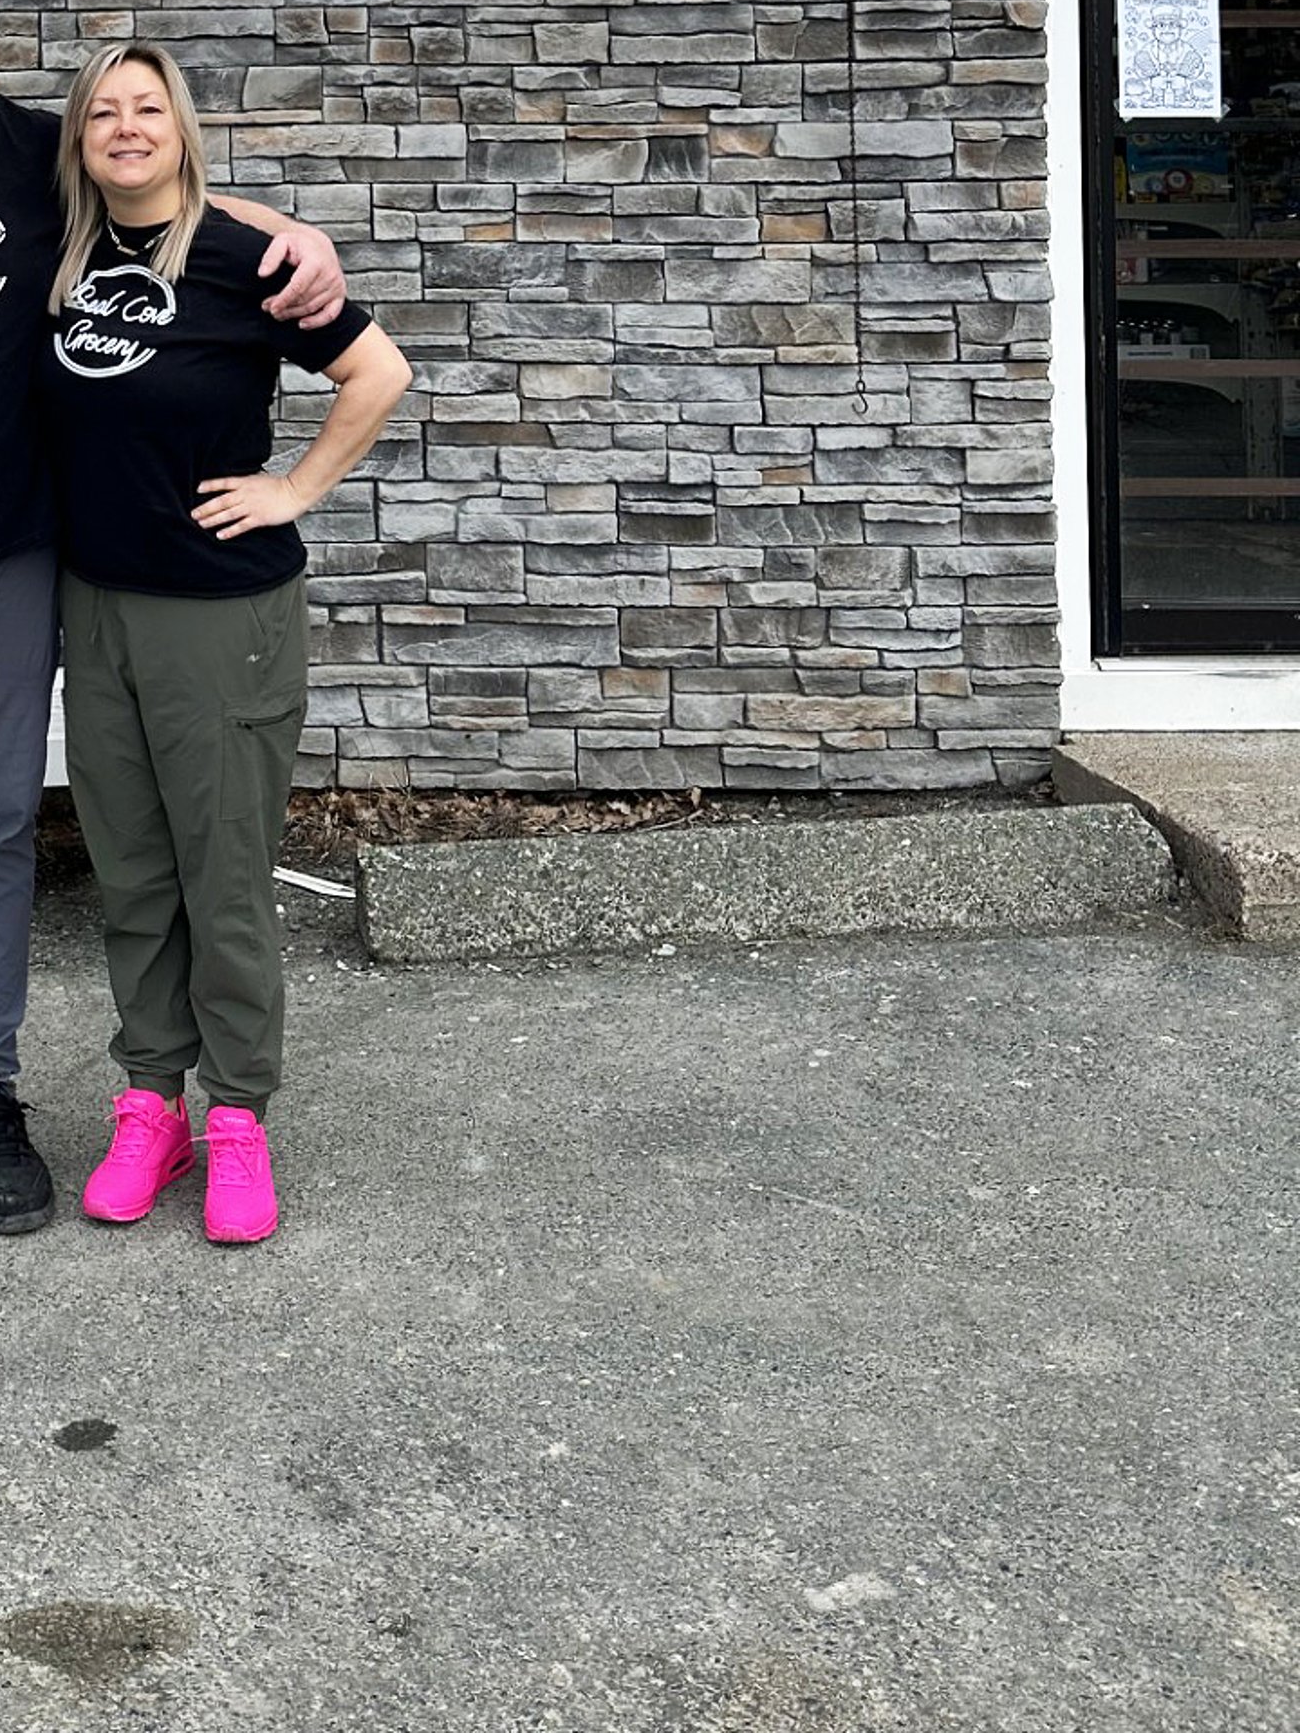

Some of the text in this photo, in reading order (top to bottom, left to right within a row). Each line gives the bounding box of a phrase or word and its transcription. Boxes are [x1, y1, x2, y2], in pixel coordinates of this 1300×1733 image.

[78, 285, 175, 326] Seal Cove
[64, 319, 140, 367] Grocery
